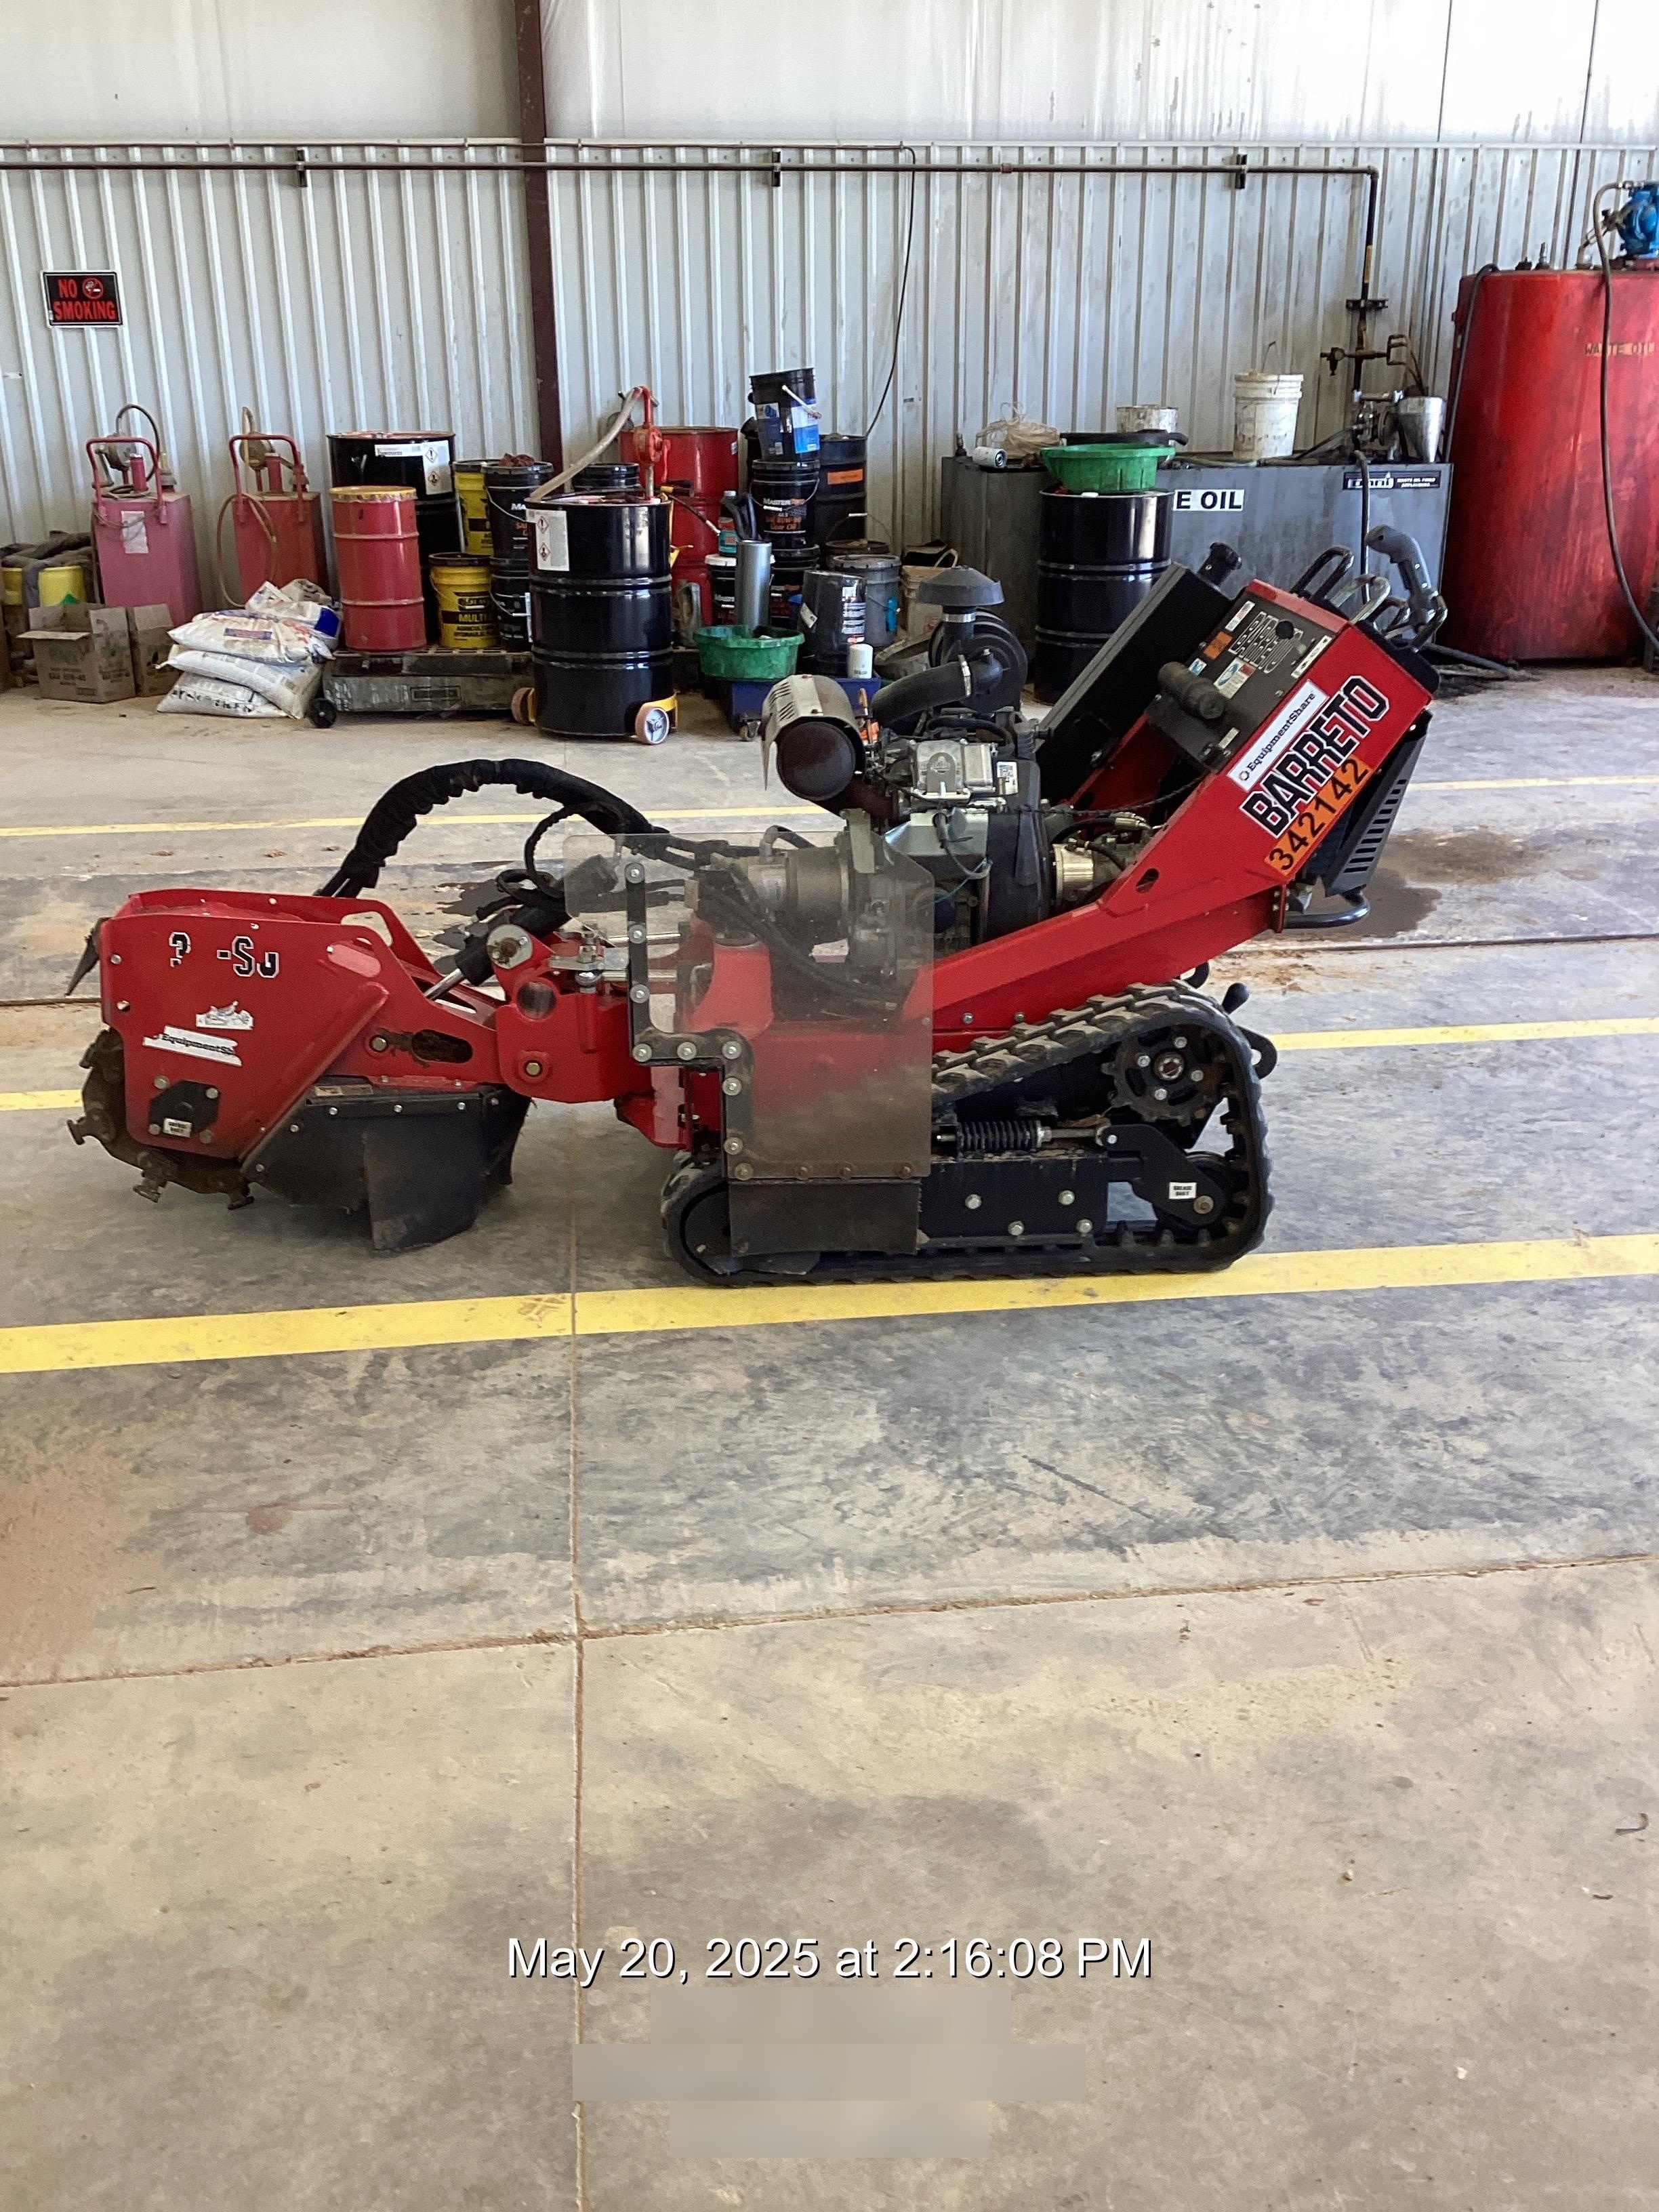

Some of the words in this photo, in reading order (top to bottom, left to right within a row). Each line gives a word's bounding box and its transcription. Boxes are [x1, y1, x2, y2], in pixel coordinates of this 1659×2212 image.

[58, 279, 77, 298] NO
[54, 300, 116, 321] SMOKING
[1585, 343, 1624, 354] WATE
[1176, 491, 1191, 509] E
[1201, 491, 1242, 509] OIL
[1246, 693, 1316, 773] EquipmentShare
[1239, 676, 1389, 838] BARRETO
[1269, 758, 1368, 871] 342142
